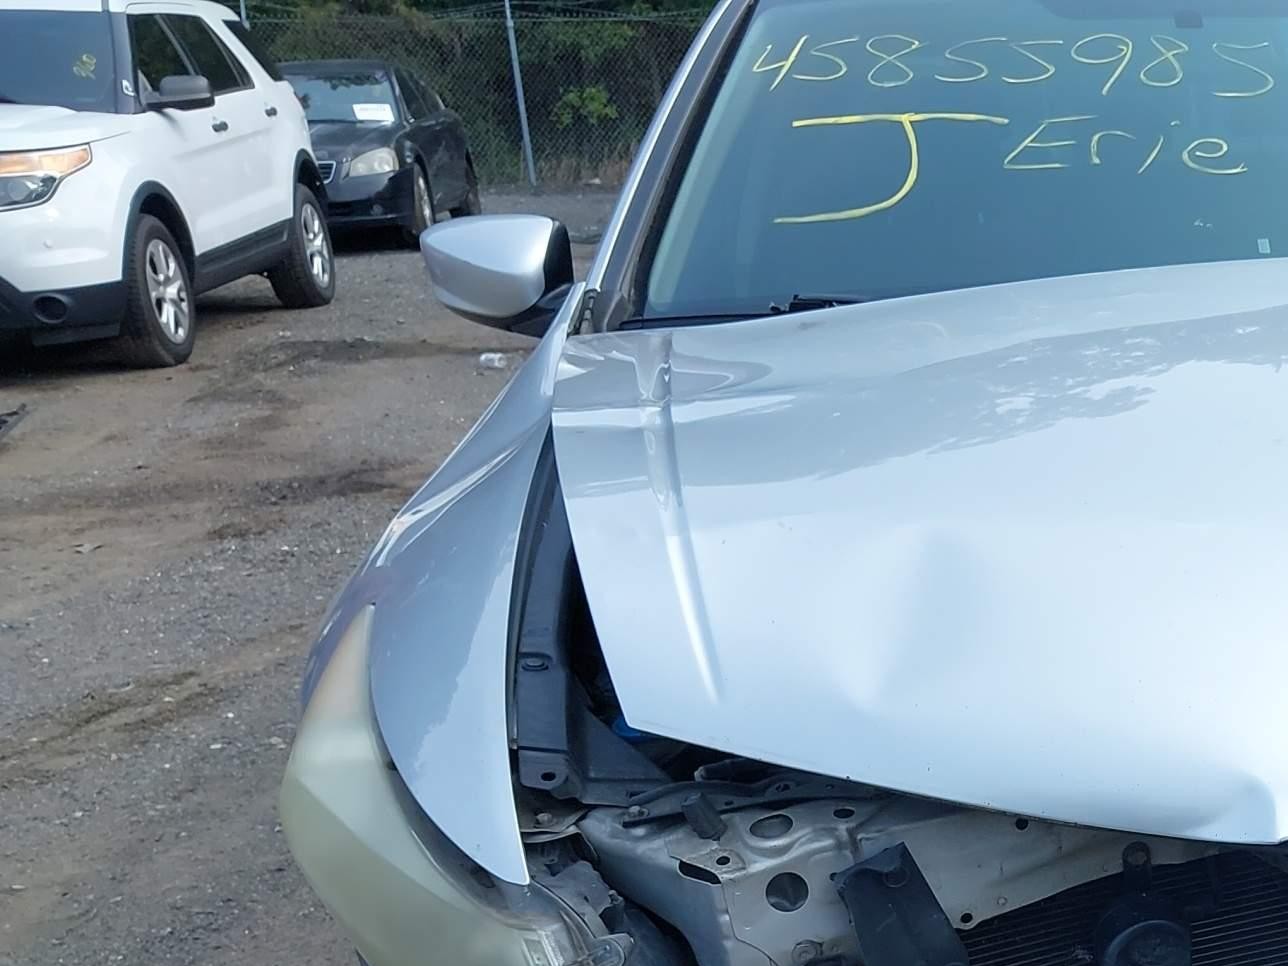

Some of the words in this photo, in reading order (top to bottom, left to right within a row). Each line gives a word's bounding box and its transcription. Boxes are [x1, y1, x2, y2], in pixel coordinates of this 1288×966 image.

[753, 33, 1275, 96] 45855985
[773, 112, 1010, 224] J
[1003, 115, 1248, 175] Erie
